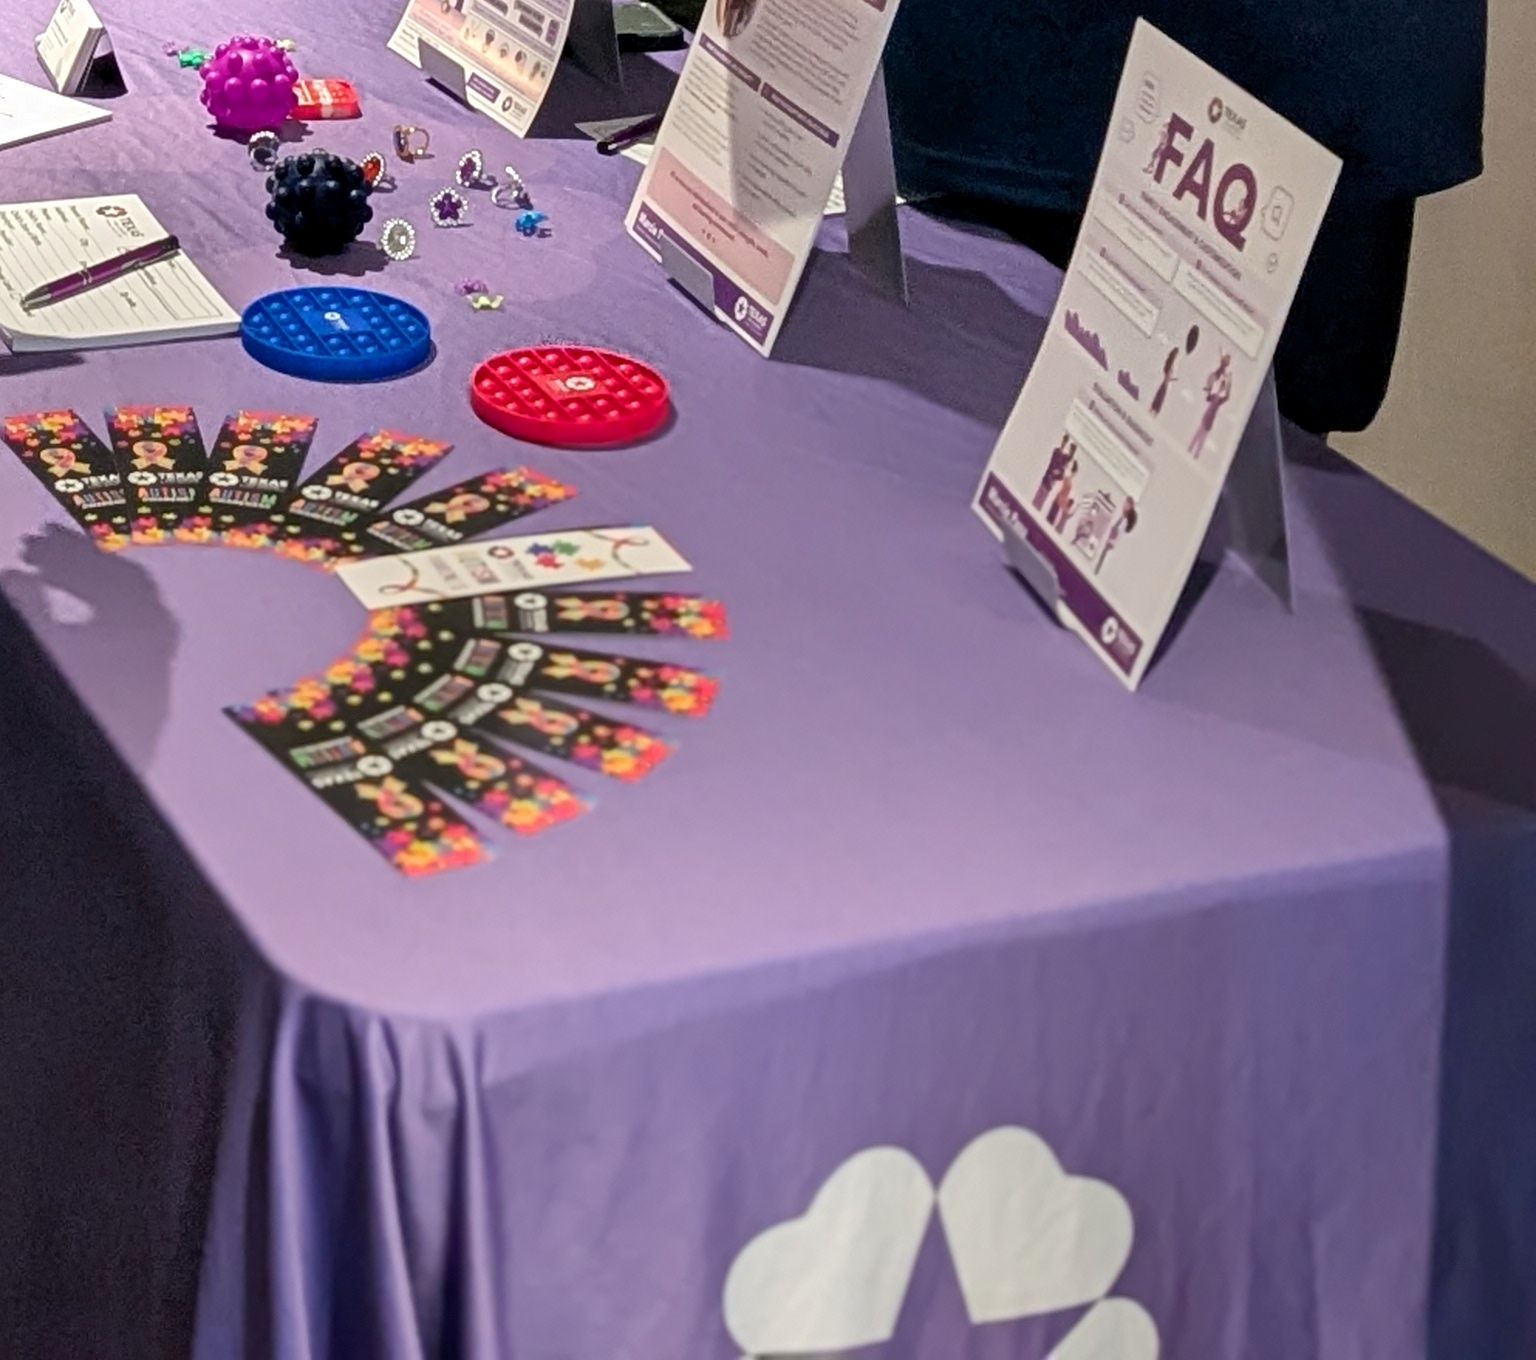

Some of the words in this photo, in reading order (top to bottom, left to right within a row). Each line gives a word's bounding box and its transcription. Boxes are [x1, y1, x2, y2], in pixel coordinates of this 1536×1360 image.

[1154, 111, 1258, 253] FAQ
[80, 472, 121, 489] TEXA
[72, 487, 126, 507] AUTIS
[208, 486, 278, 508] AUTISM
